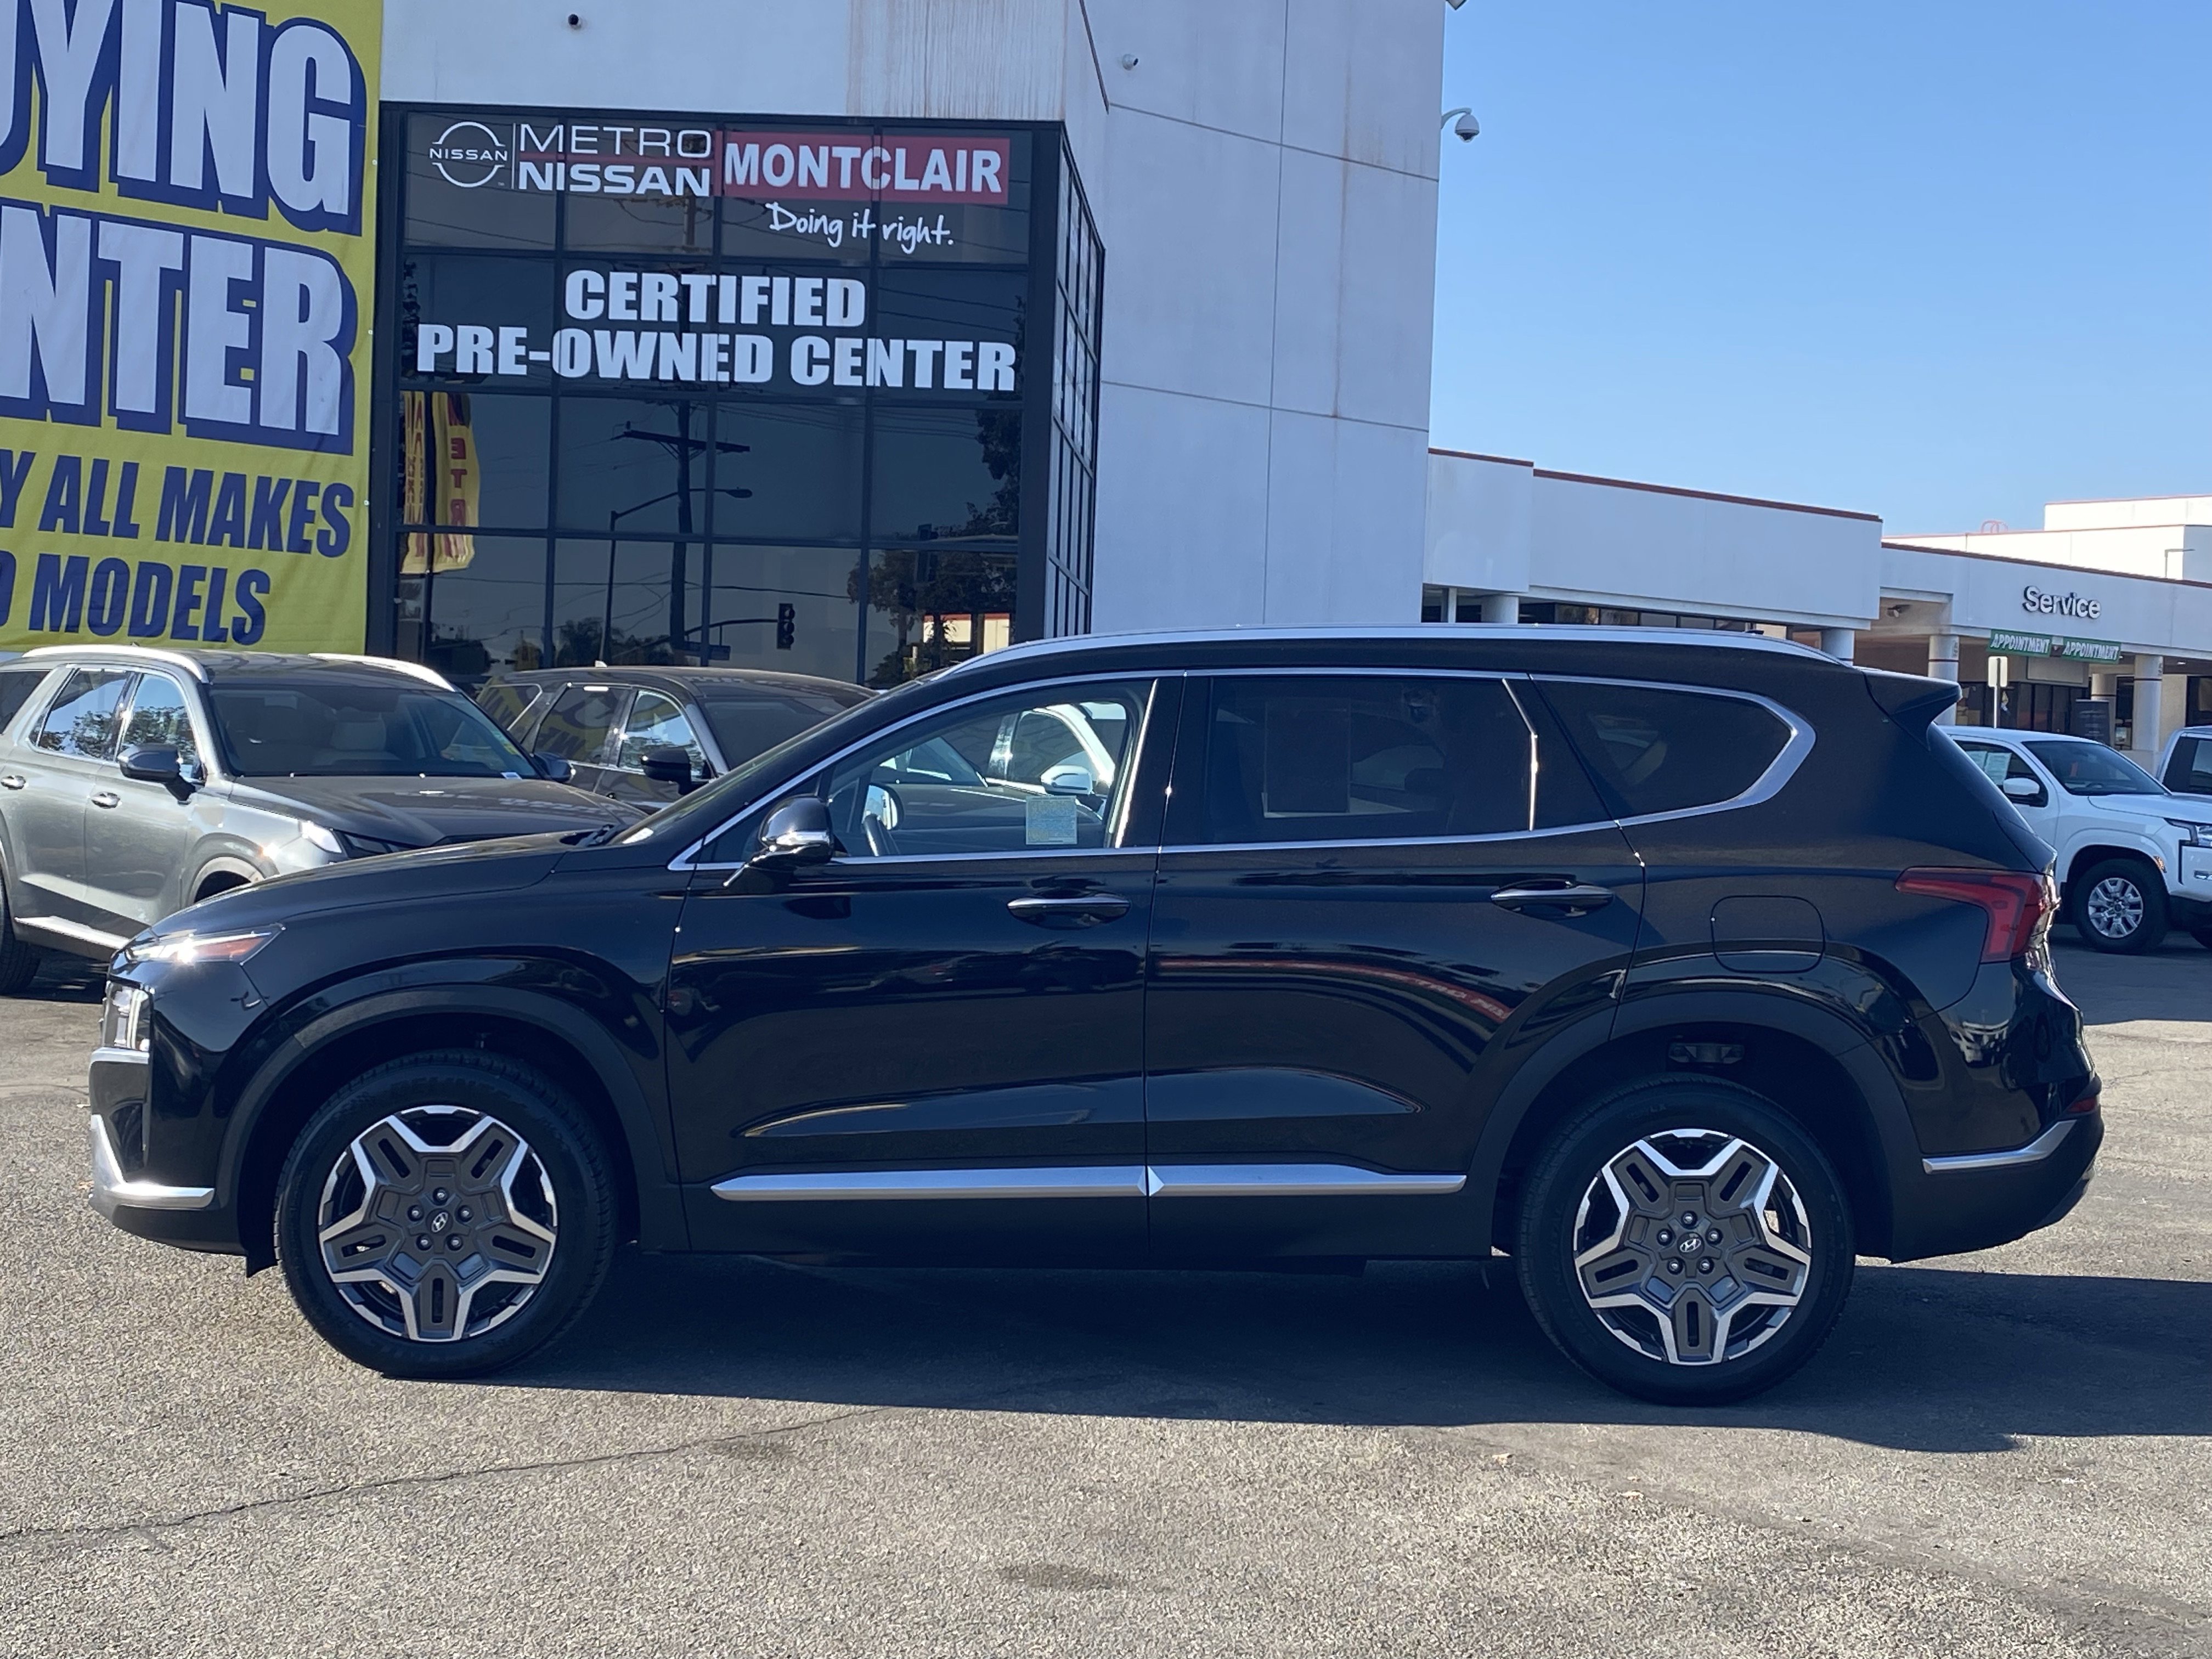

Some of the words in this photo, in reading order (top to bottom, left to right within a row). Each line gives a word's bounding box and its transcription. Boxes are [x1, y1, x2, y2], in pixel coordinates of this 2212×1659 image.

[430, 148, 508, 161] NISSAN
[520, 123, 712, 157] METRO
[518, 161, 710, 197] NISSAN
[725, 143, 1002, 193] MONTCLAIR
[765, 202, 843, 247] Doing
[851, 208, 877, 239] it
[882, 215, 954, 255] right.
[0, 205, 343, 436] NTER
[565, 269, 866, 328] CERTIFIED
[417, 323, 774, 383] PRE-OWNED
[790, 335, 1017, 392] CENTER
[38, 455, 140, 539] ALL
[155, 466, 354, 558] MAKES
[29, 553, 270, 646] MODELS
[2023, 585, 2101, 619] Service
[1990, 633, 2051, 654] APPOINTMENT
[2062, 641, 2119, 661] APPOINTMENT
